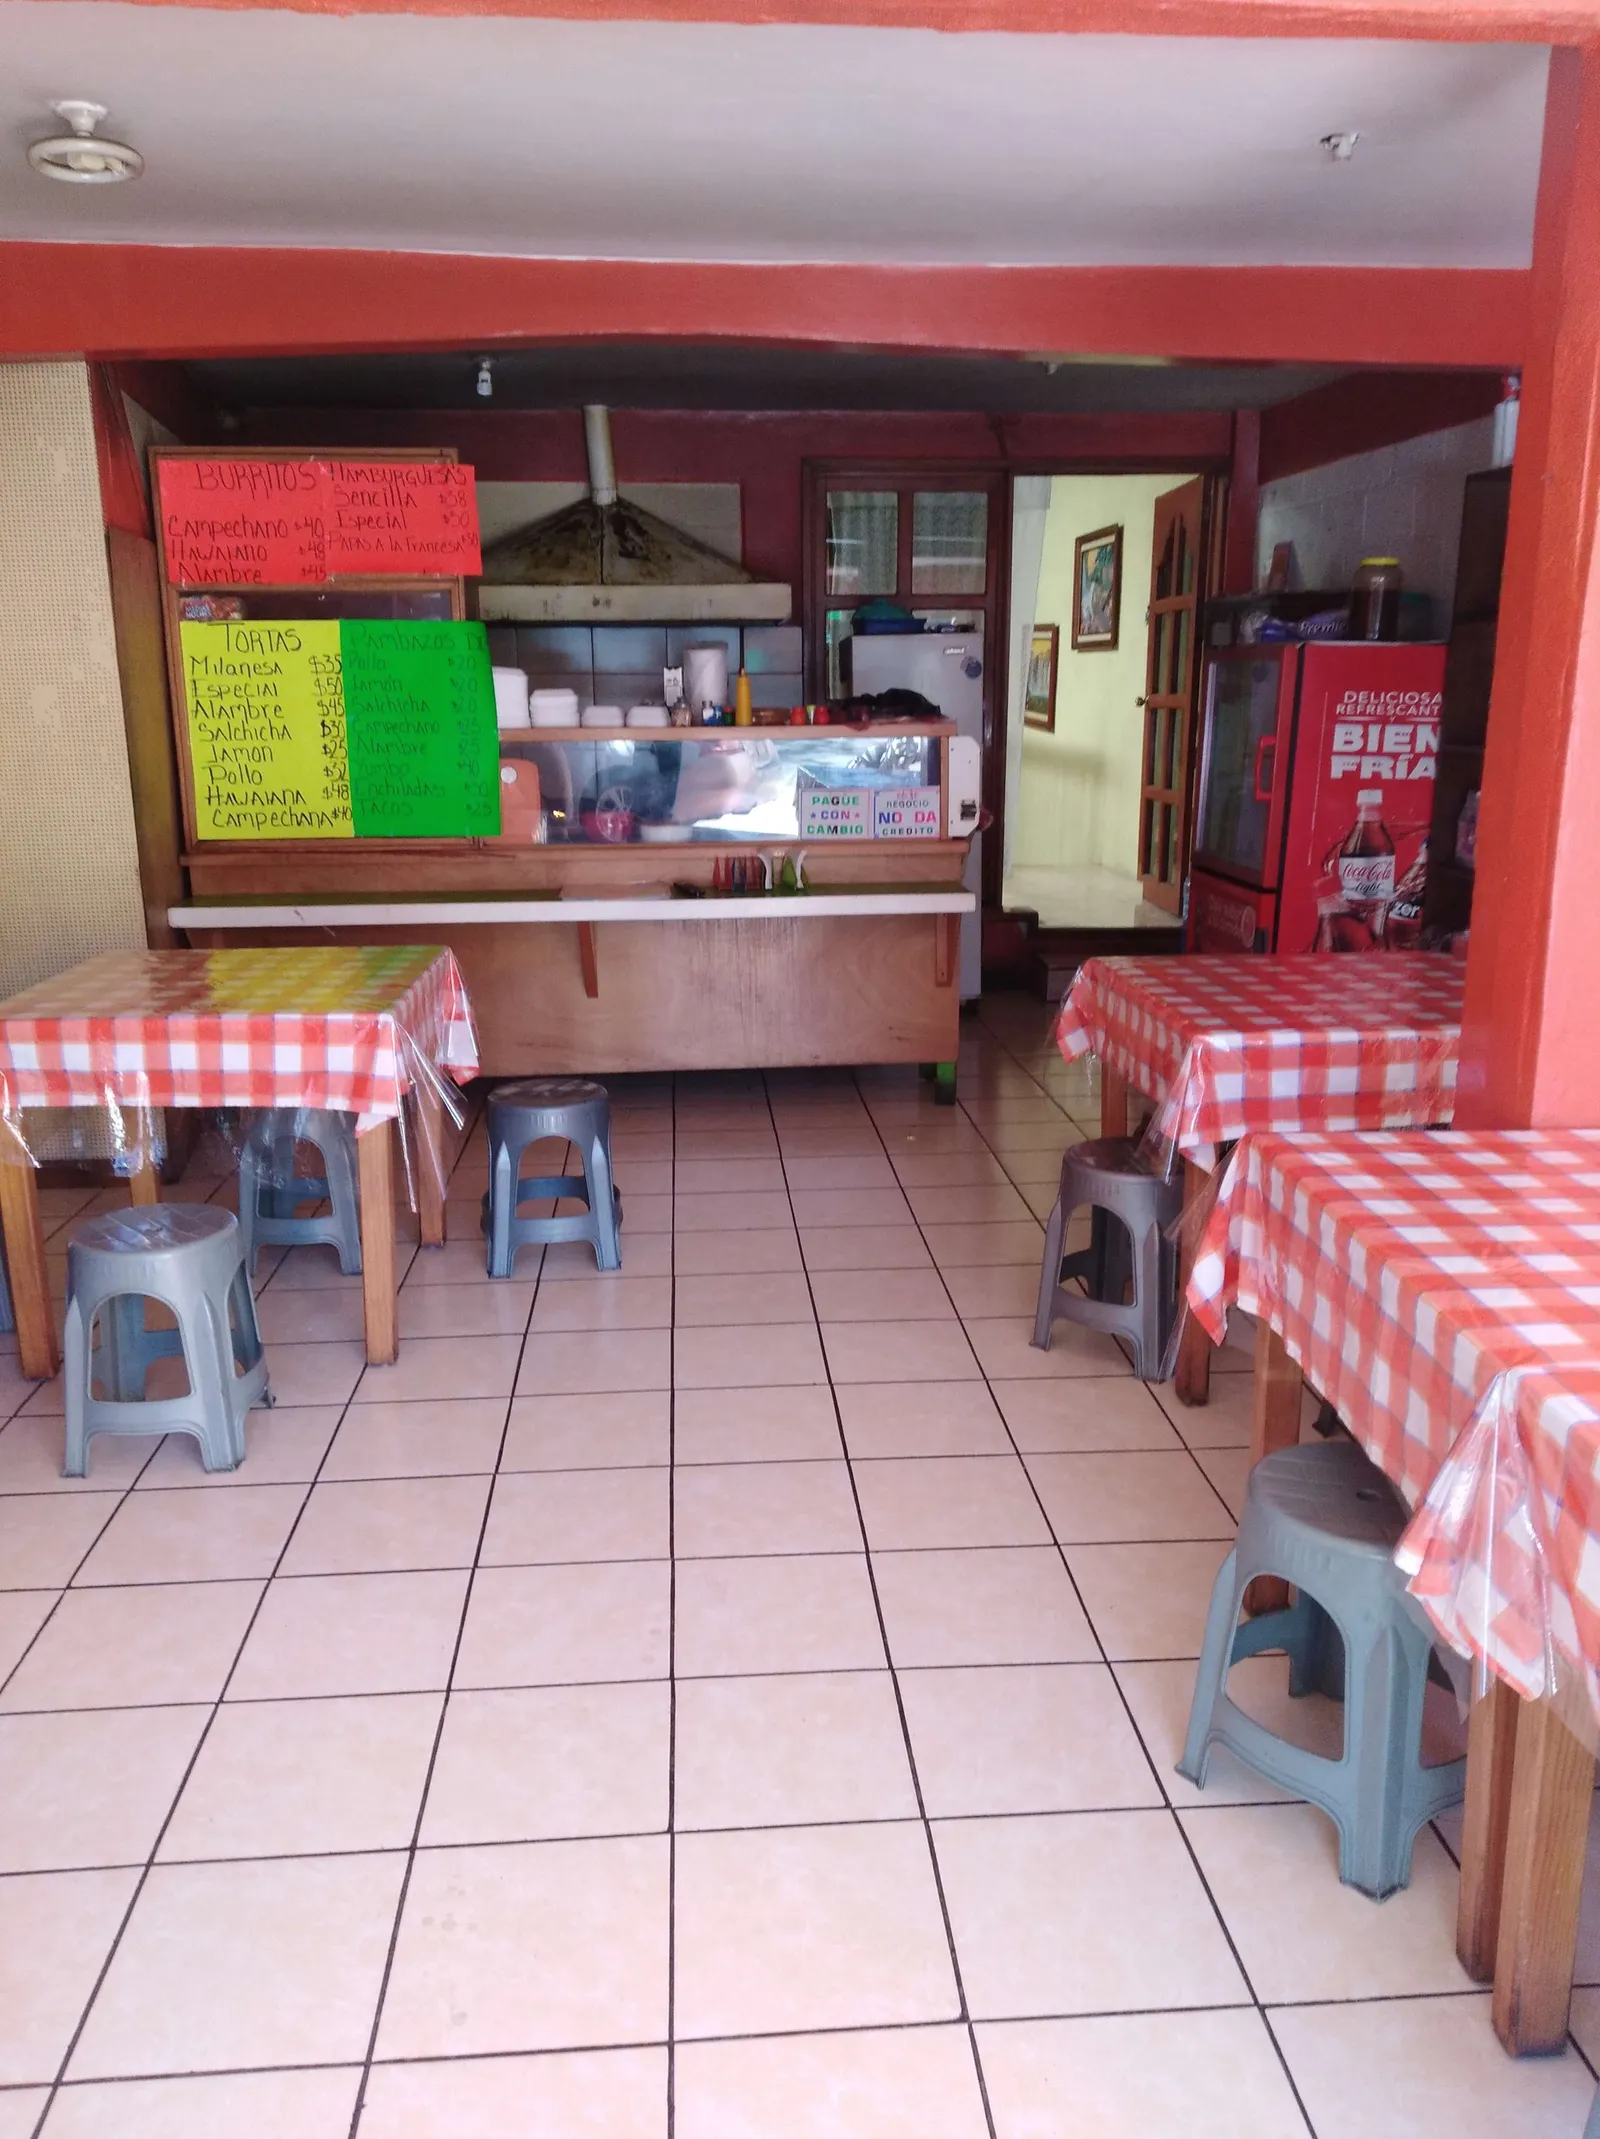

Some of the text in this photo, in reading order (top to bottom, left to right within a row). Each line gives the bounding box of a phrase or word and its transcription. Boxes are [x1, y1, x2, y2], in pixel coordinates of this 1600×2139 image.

[193, 463, 317, 500] BURRITOS
[207, 623, 302, 654] TORTAS
[308, 654, 343, 676] $35
[314, 676, 344, 696] $50
[1343, 690, 1442, 704] DELICIOSA
[317, 698, 346, 717] $45
[320, 719, 346, 739] $30
[1332, 723, 1440, 754] BIEN
[321, 740, 348, 760] $25
[201, 763, 350, 786] Pollo $32
[1330, 753, 1436, 780] FRÍA
[321, 783, 350, 801] $48
[812, 796, 860, 806] PAGUE
[886, 800, 929, 809] NEGOCIO
[331, 805, 353, 824] $40
[820, 810, 850, 821] CON
[878, 810, 937, 824] NO DA
[806, 824, 864, 836] CAMBIO
[882, 826, 933, 836] CREDITO
